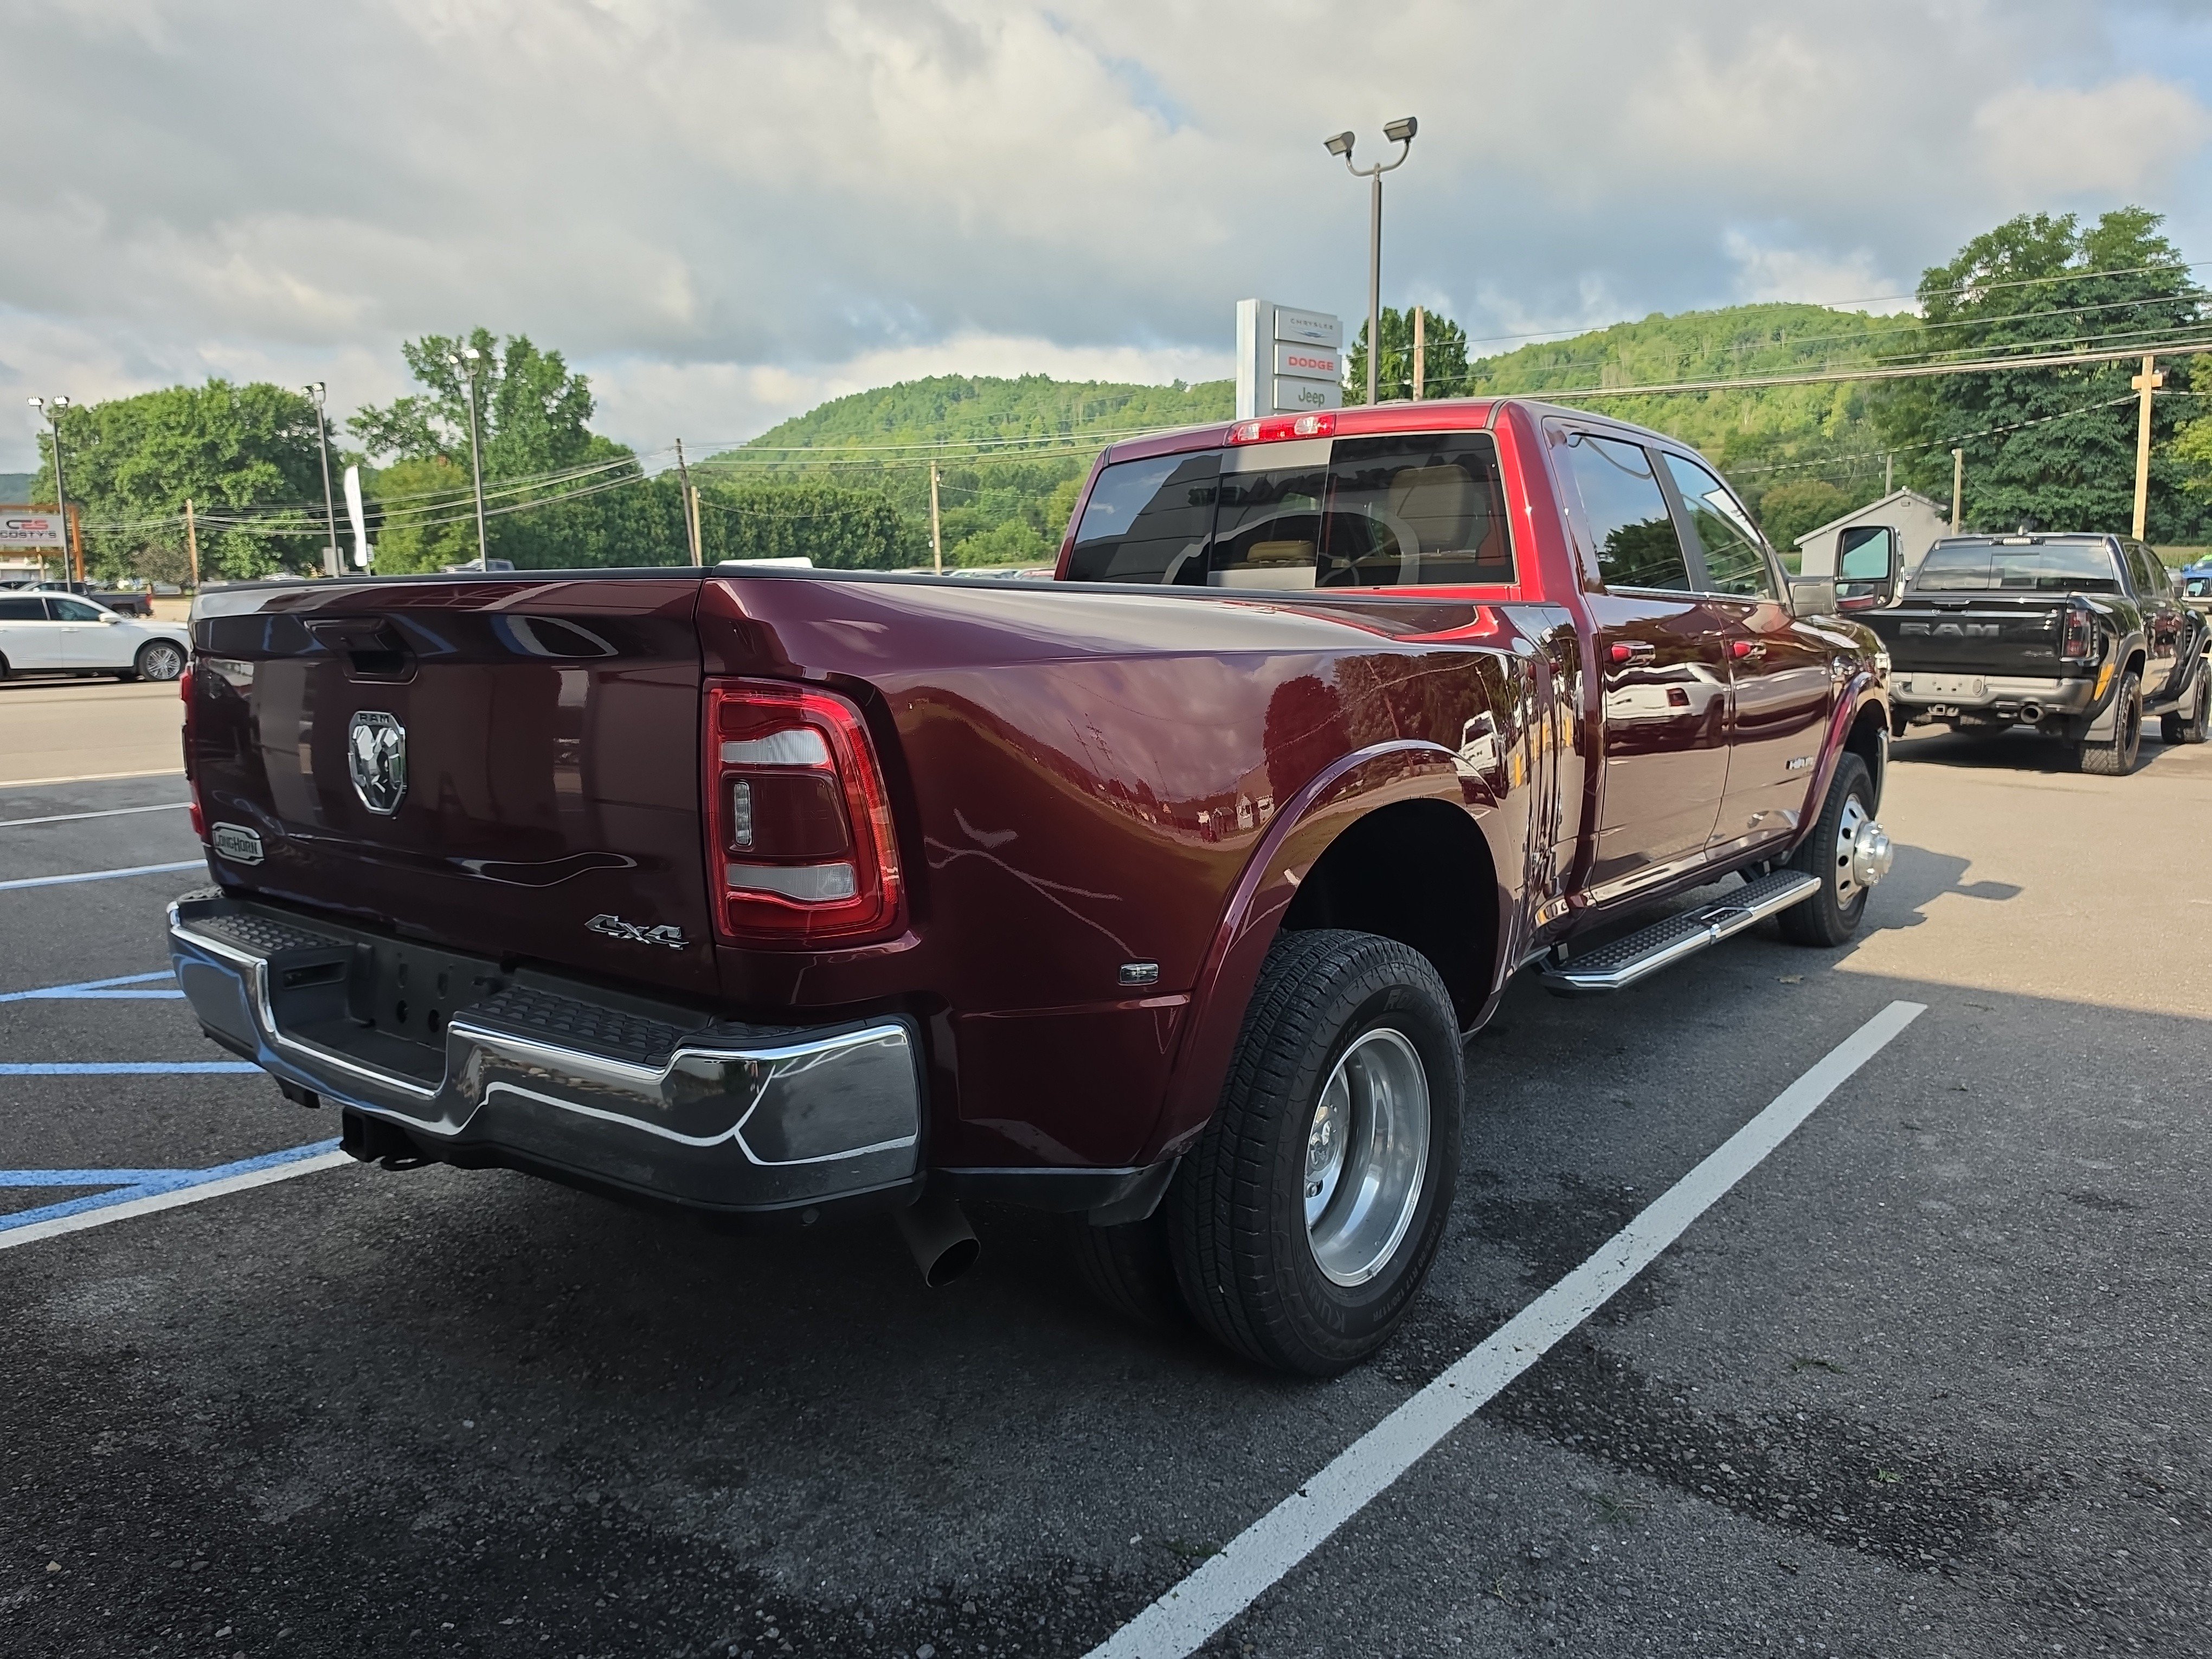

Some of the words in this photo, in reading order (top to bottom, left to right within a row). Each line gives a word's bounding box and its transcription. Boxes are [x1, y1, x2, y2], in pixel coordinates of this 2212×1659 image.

[1290, 318, 1334, 331] CHRYSLER
[1288, 356, 1334, 371] DODGE
[1298, 387, 1324, 407] Jeep
[1899, 622, 1999, 636] RAM
[359, 713, 390, 723] RAM
